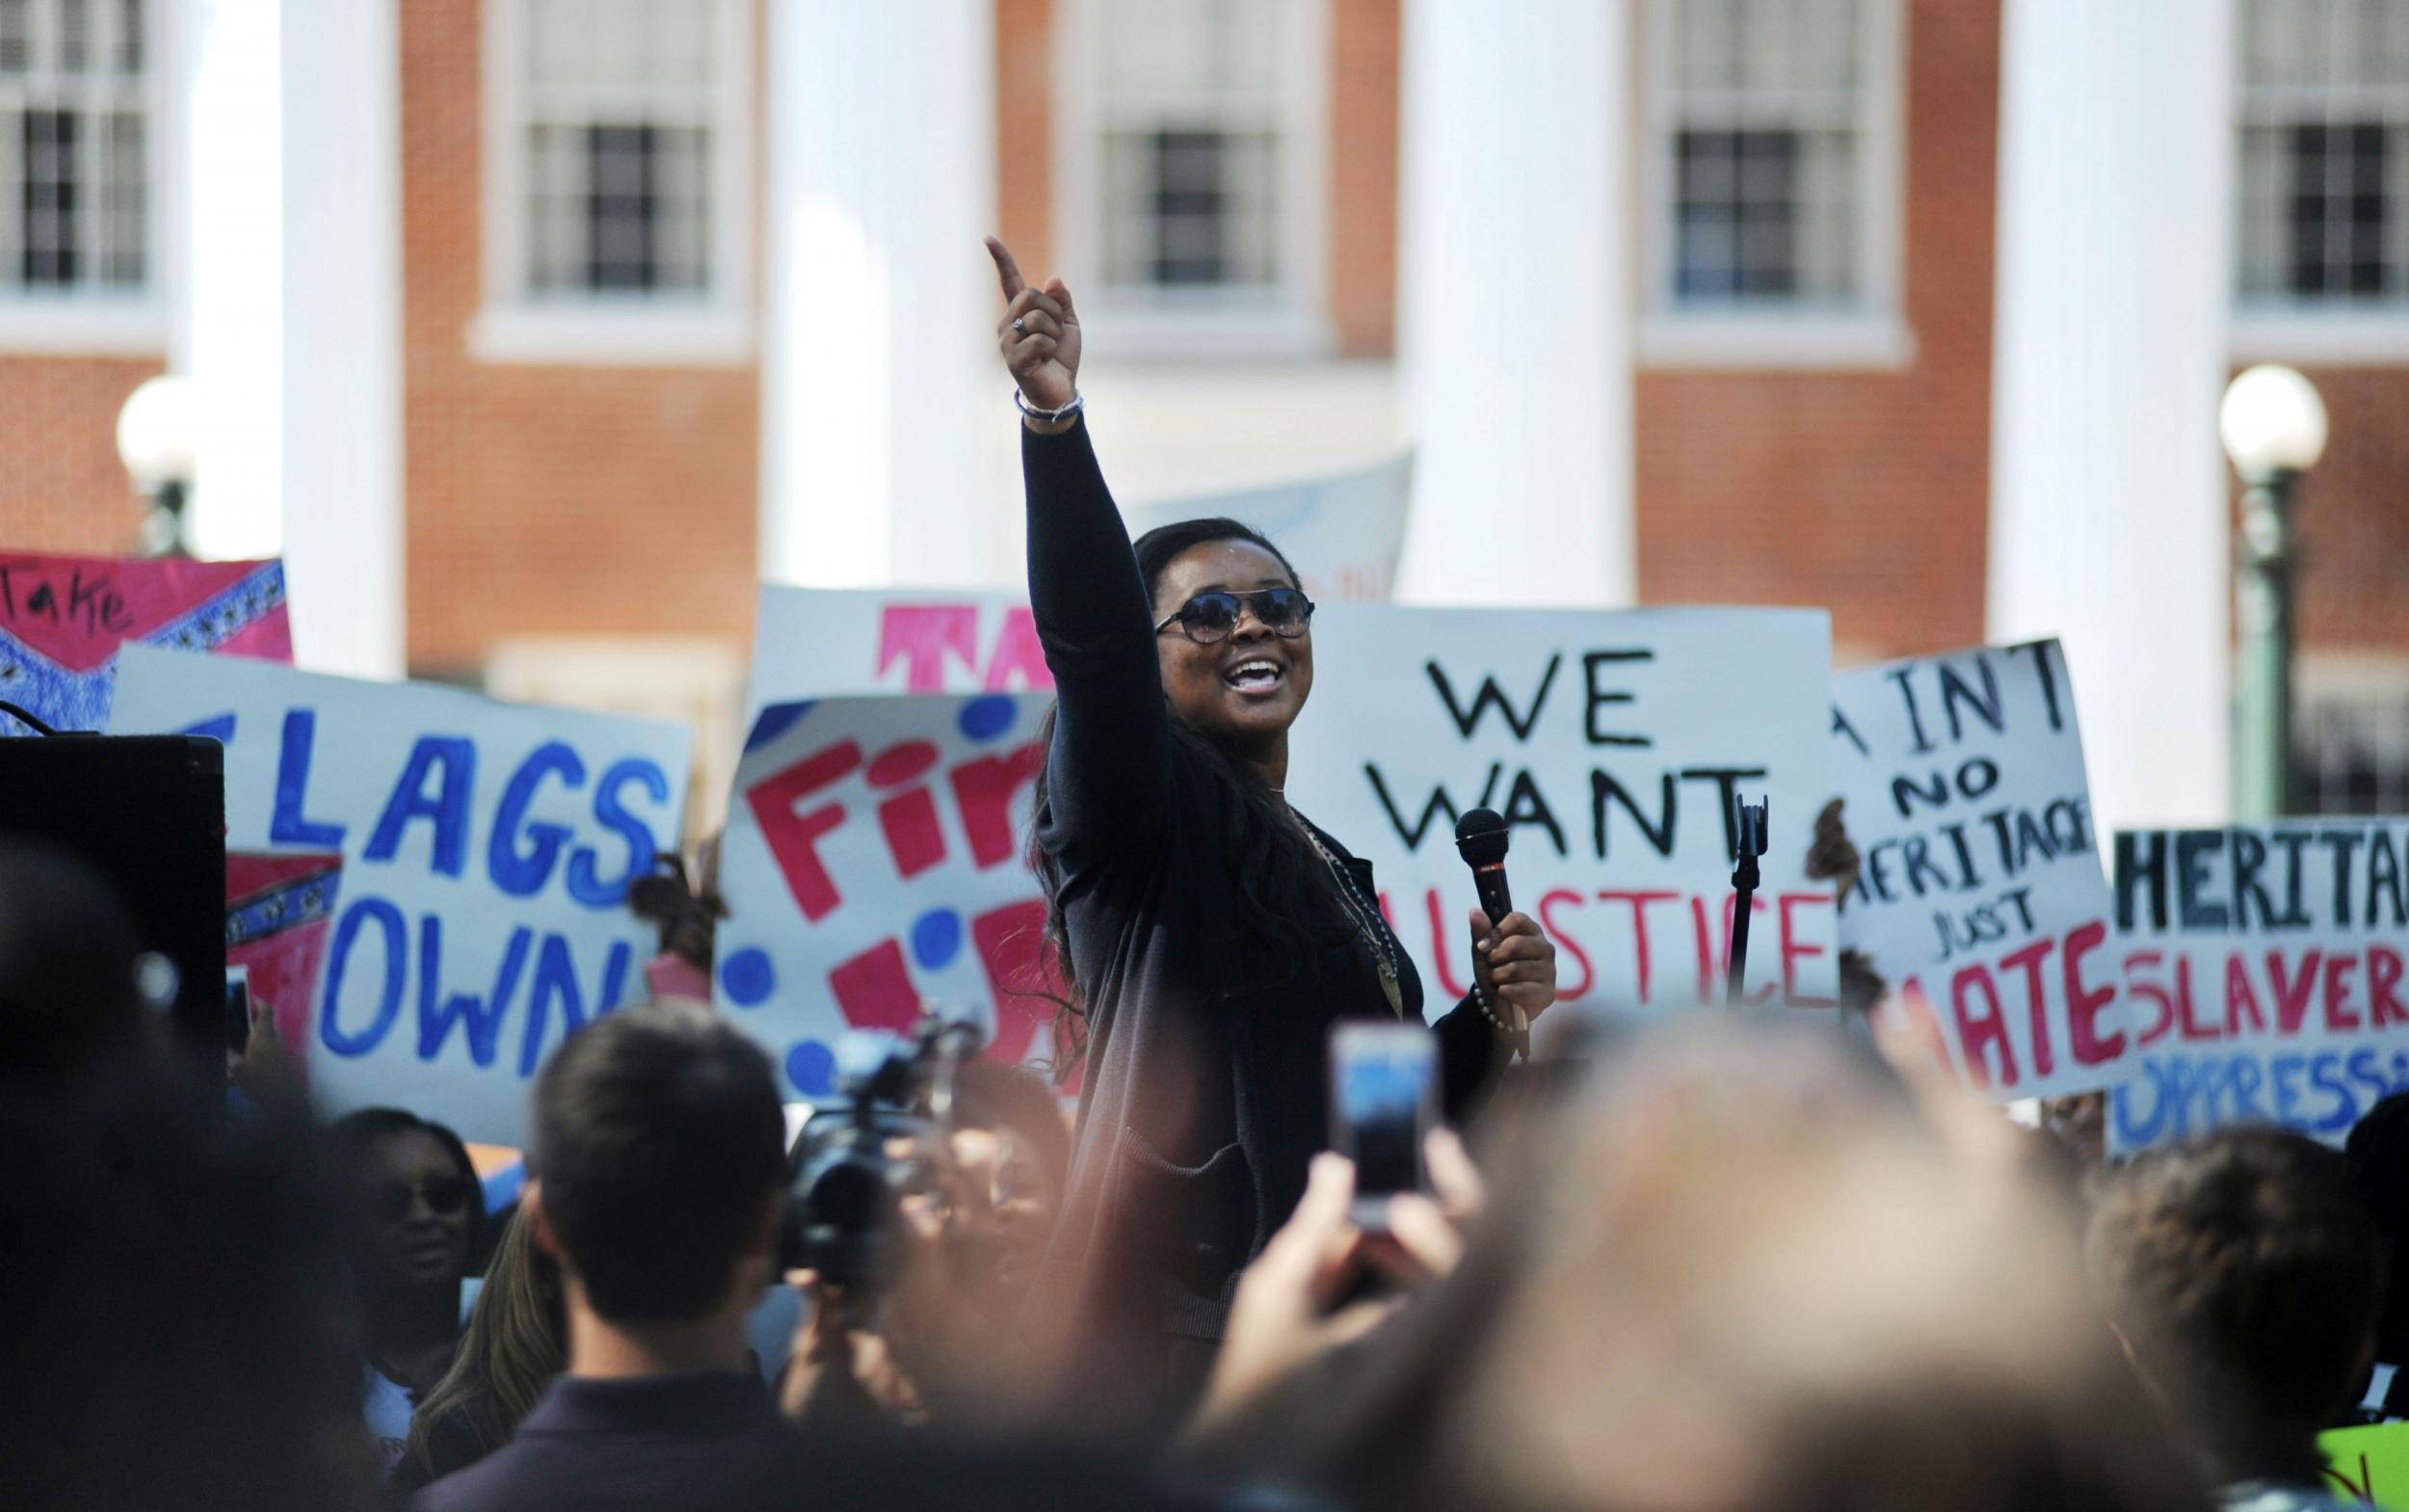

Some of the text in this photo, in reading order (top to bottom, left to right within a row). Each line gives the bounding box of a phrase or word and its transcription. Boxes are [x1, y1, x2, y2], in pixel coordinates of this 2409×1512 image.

[1426, 649, 1655, 747] WE
[172, 706, 670, 911] LAGS
[746, 738, 1050, 925] Fir
[1365, 762, 1766, 863] WANT
[1891, 756, 2000, 819] NO
[1933, 887, 2037, 962] JUST
[2113, 827, 2409, 930] HERITA
[1378, 887, 1837, 1008] USTICE
[1901, 917, 2128, 1089] ATE
[2113, 1047, 2409, 1147] OPPRESS
